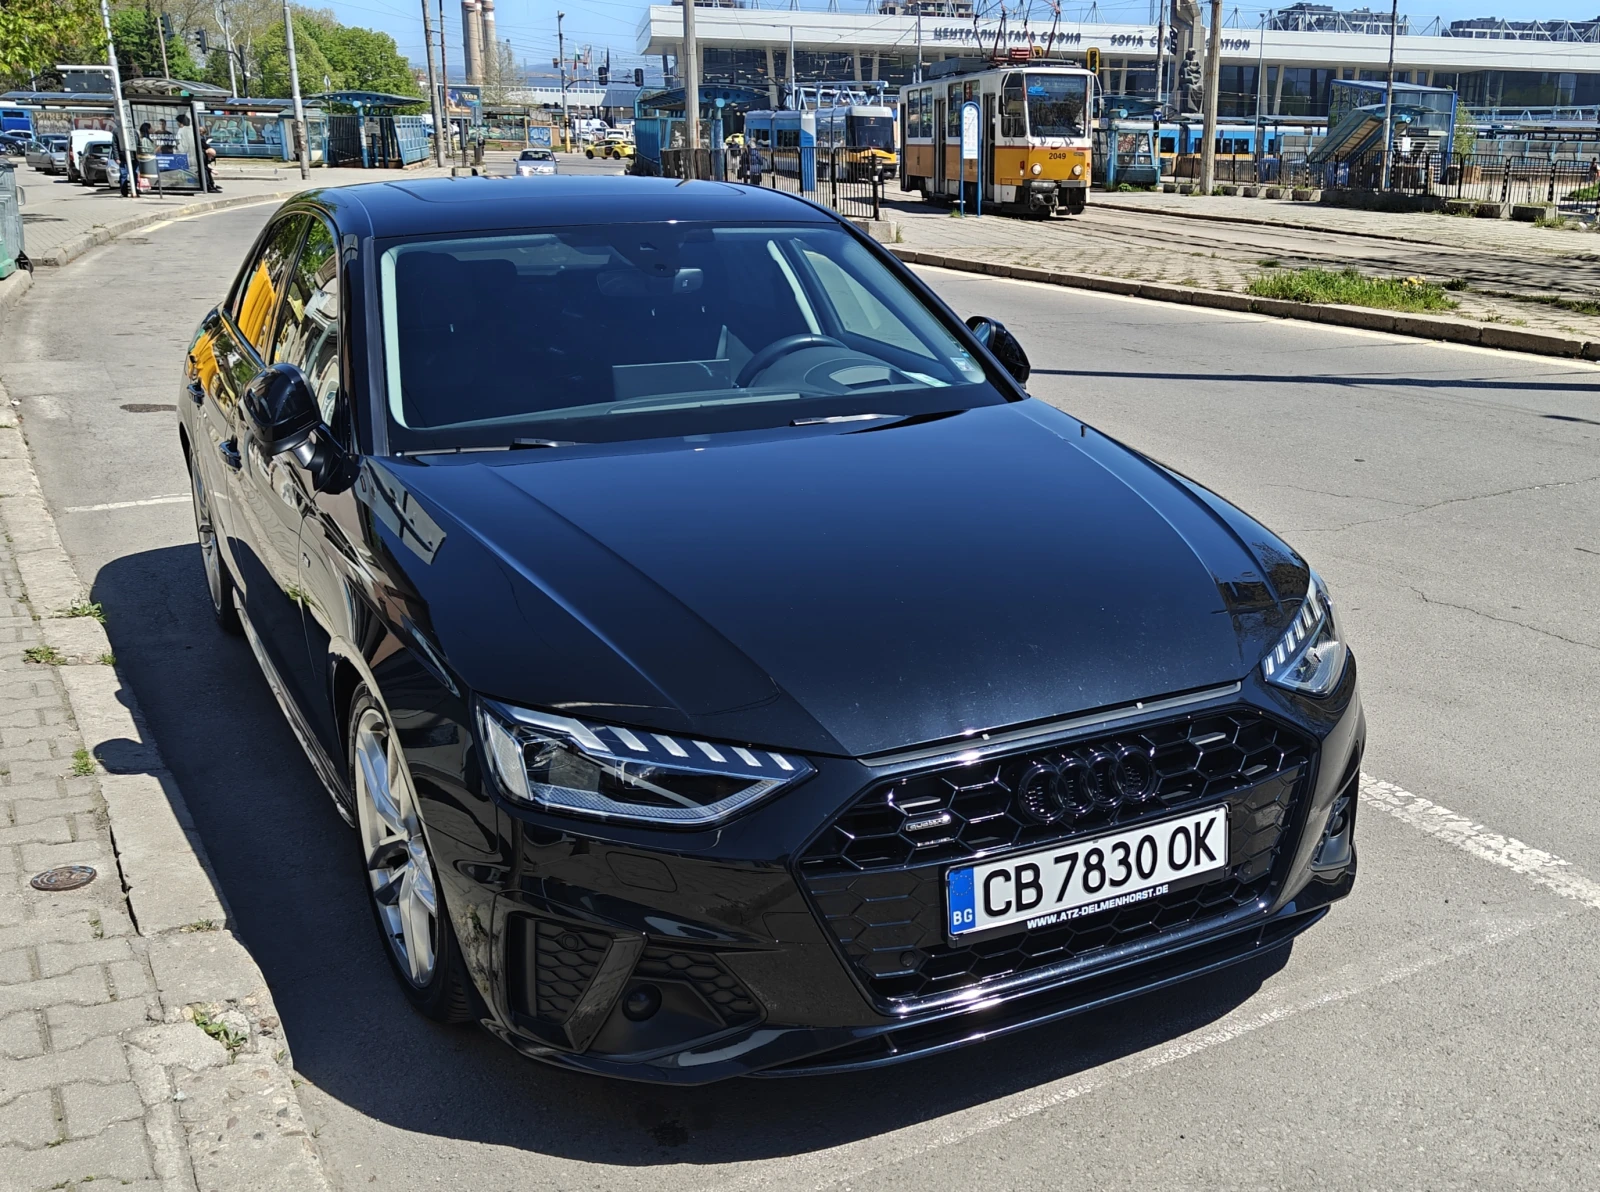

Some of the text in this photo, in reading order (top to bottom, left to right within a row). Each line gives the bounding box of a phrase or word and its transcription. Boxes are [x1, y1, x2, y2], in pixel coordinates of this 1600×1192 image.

[1110, 34, 1144, 47] SOFIA
[1048, 152, 1067, 160] 2049
[983, 817, 1217, 917] CB 7830 OK
[1026, 884, 1169, 929] WWW.ATZ-DELMENHORST.DE
[953, 908, 973, 926] BG
